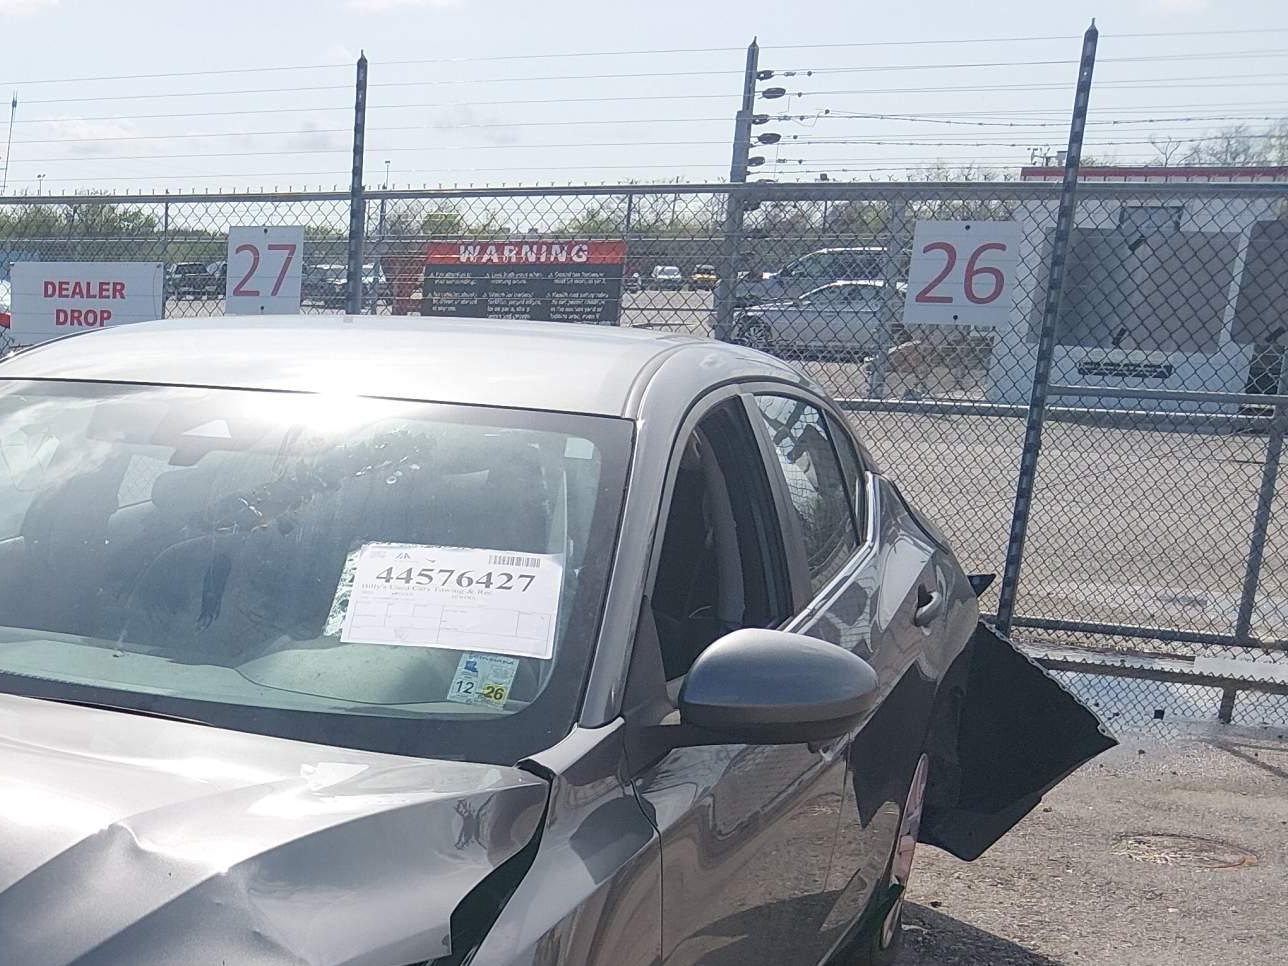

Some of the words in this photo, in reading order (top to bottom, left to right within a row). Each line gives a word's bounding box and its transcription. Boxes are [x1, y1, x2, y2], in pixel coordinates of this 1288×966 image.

[459, 244, 588, 263] WARNING
[232, 243, 297, 297] 27
[915, 241, 1007, 304] 26
[43, 280, 126, 299] DEALER
[55, 309, 112, 327] DROP
[376, 566, 535, 593] 44576427
[456, 681, 474, 694] 12
[484, 686, 504, 701] 26
